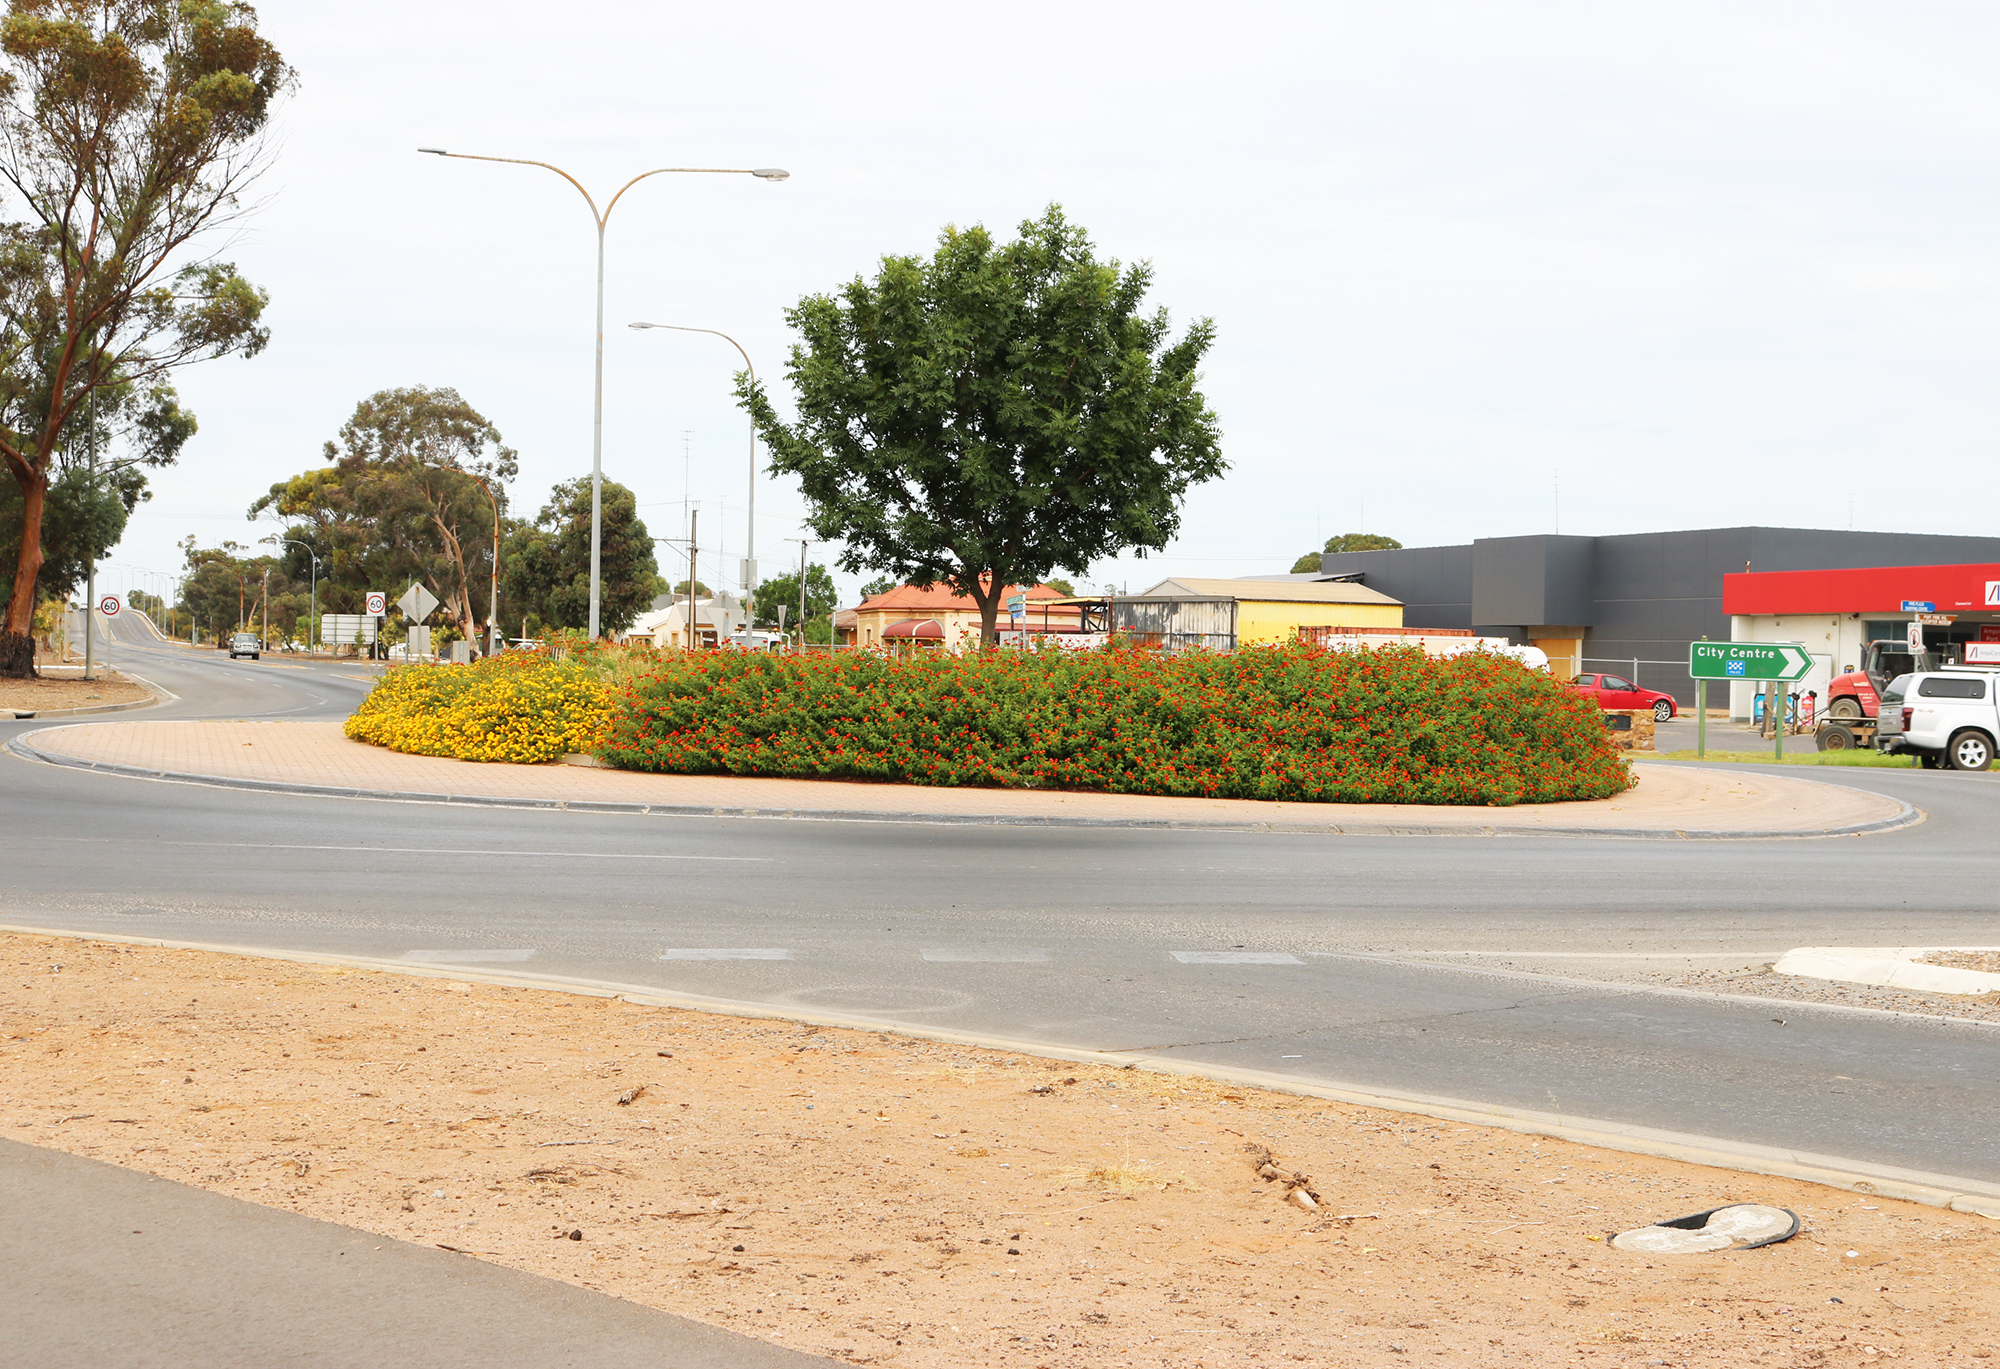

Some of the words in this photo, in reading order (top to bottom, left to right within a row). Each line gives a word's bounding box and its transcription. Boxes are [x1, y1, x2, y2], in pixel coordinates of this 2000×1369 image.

[104, 602, 116, 610] 60
[370, 600, 382, 608] 60
[1698, 647, 1725, 659] City
[1730, 648, 1775, 659] Centre
